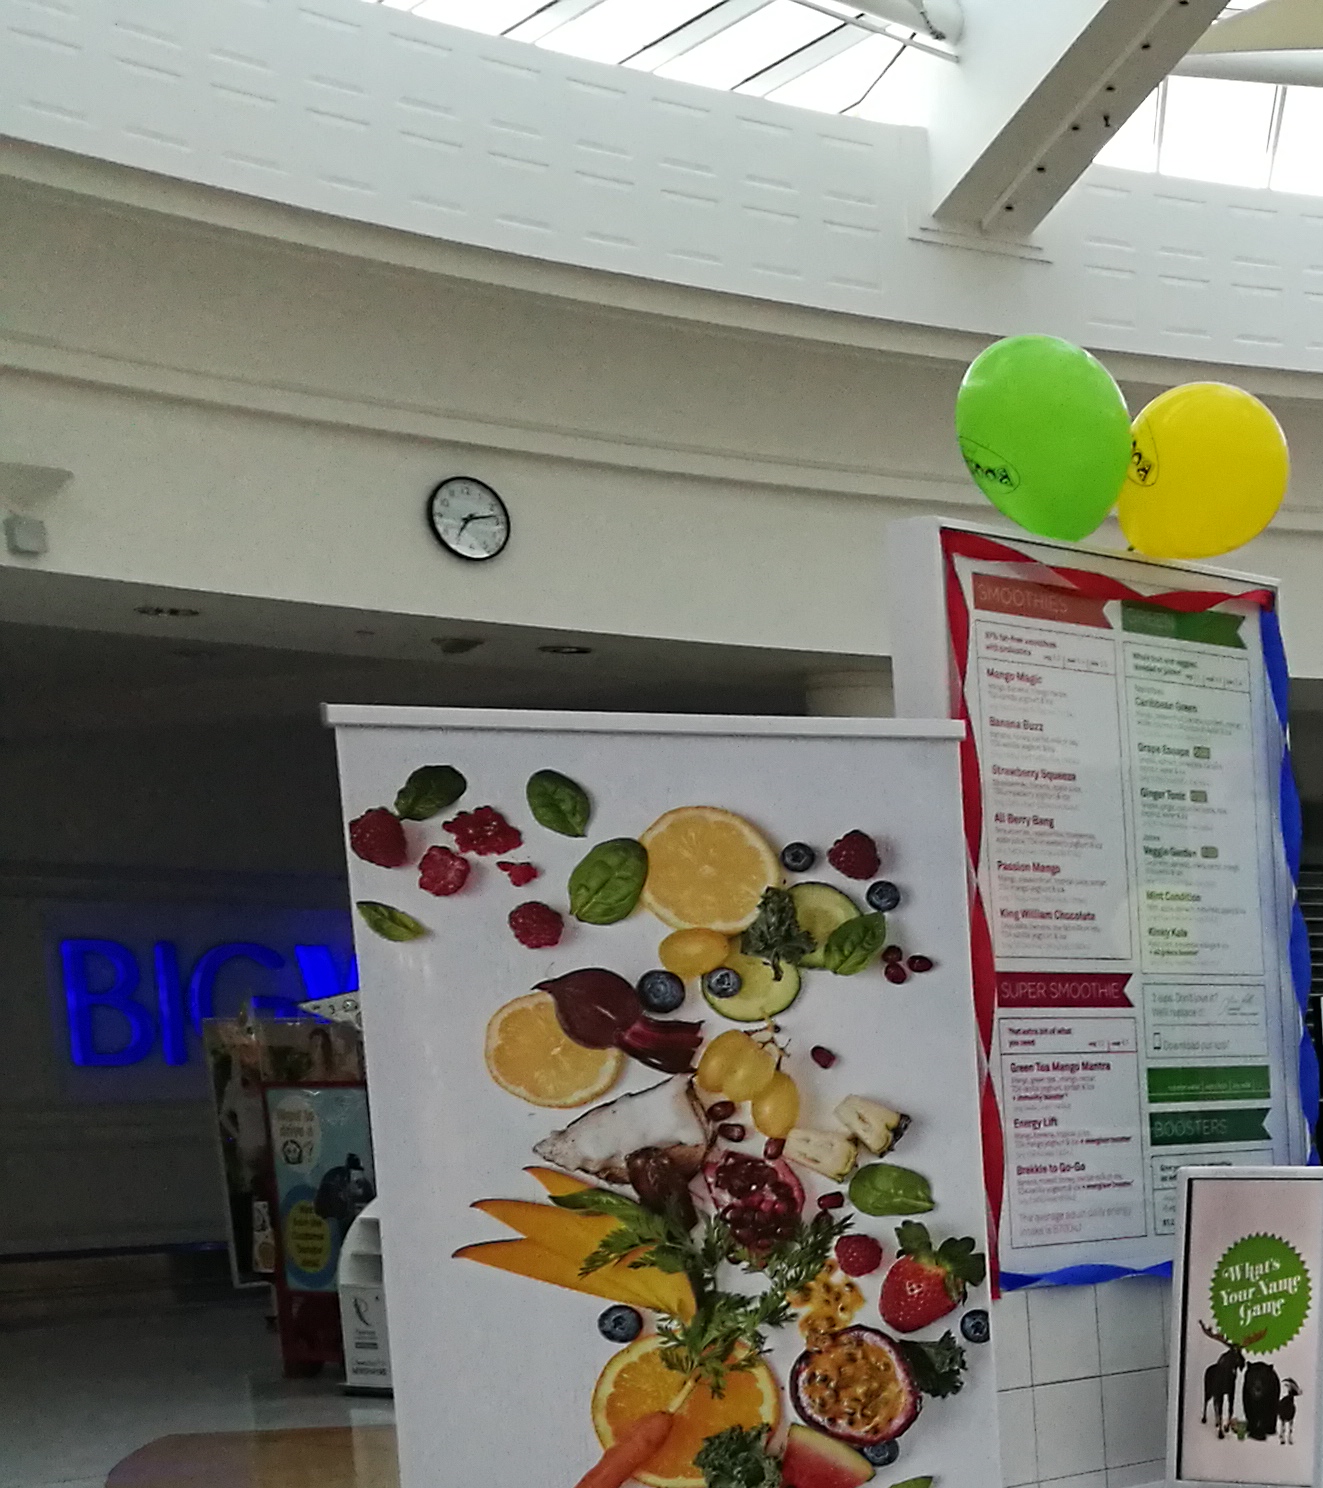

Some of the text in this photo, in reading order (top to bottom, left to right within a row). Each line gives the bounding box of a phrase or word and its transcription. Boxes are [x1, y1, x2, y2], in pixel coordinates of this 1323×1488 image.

[989, 717, 1044, 731] Banana Buzz
[992, 765, 1039, 780] Strawberry
[1007, 813, 1030, 826] Berry
[1032, 815, 1054, 828] Bang
[997, 860, 1061, 876] Passion Mango
[1165, 891, 1202, 902] Condition
[1000, 908, 1096, 921] King William Chocolate
[1001, 982, 1120, 999] SUPER SMOOTHIE
[1010, 1061, 1111, 1074] Green Tea Mango Mantra
[1013, 1116, 1058, 1130] Energy Lift
[1154, 1118, 1228, 1137] BOOSTERS
[1049, 1165, 1057, 1173] to
[1060, 1162, 1086, 1172] Go-Go
[1222, 1258, 1281, 1282] What's
[1220, 1275, 1301, 1306] Your Name
[1239, 1298, 1285, 1327] Game
